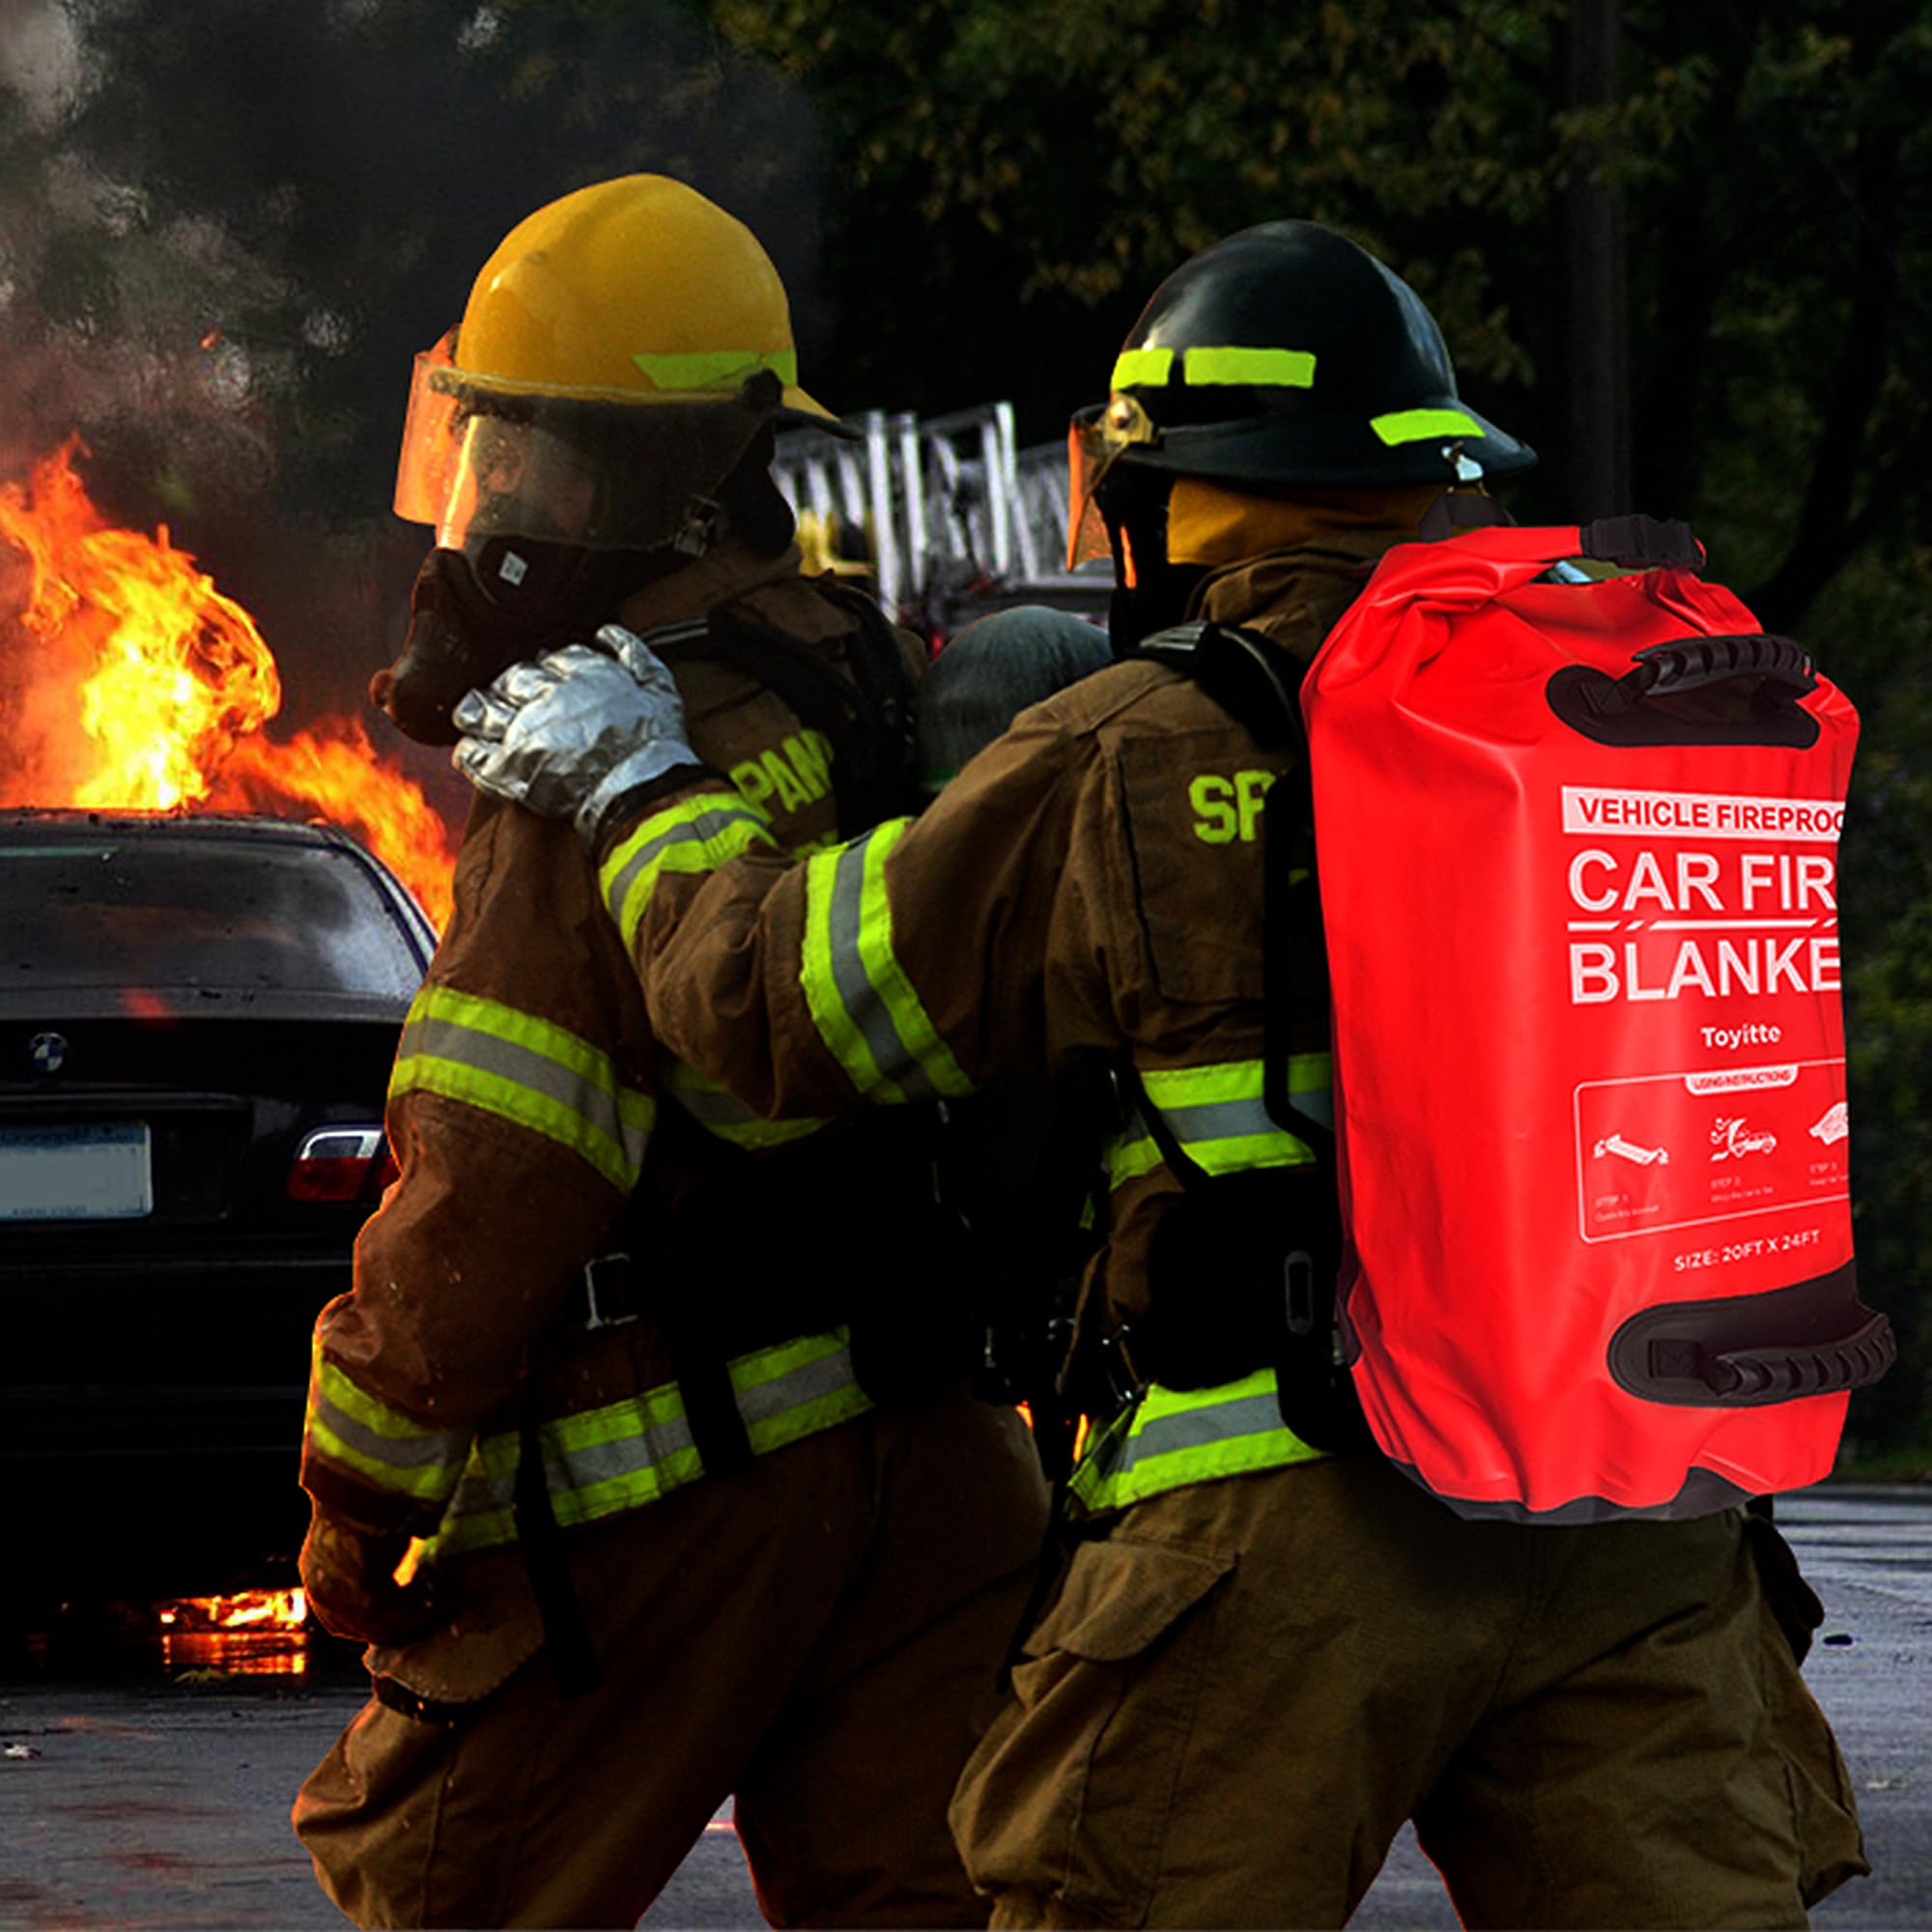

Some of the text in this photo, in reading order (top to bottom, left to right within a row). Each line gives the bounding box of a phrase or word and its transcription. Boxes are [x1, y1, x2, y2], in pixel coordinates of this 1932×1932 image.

[1578, 797, 1709, 828] VEHICLE
[1569, 849, 1724, 912] CAR
[1700, 1023, 1781, 1049] Toyitte
[1674, 1248, 1719, 1271] SIZE:
[1721, 1239, 1764, 1263] 20FT
[1781, 1229, 1820, 1250] 24FT
